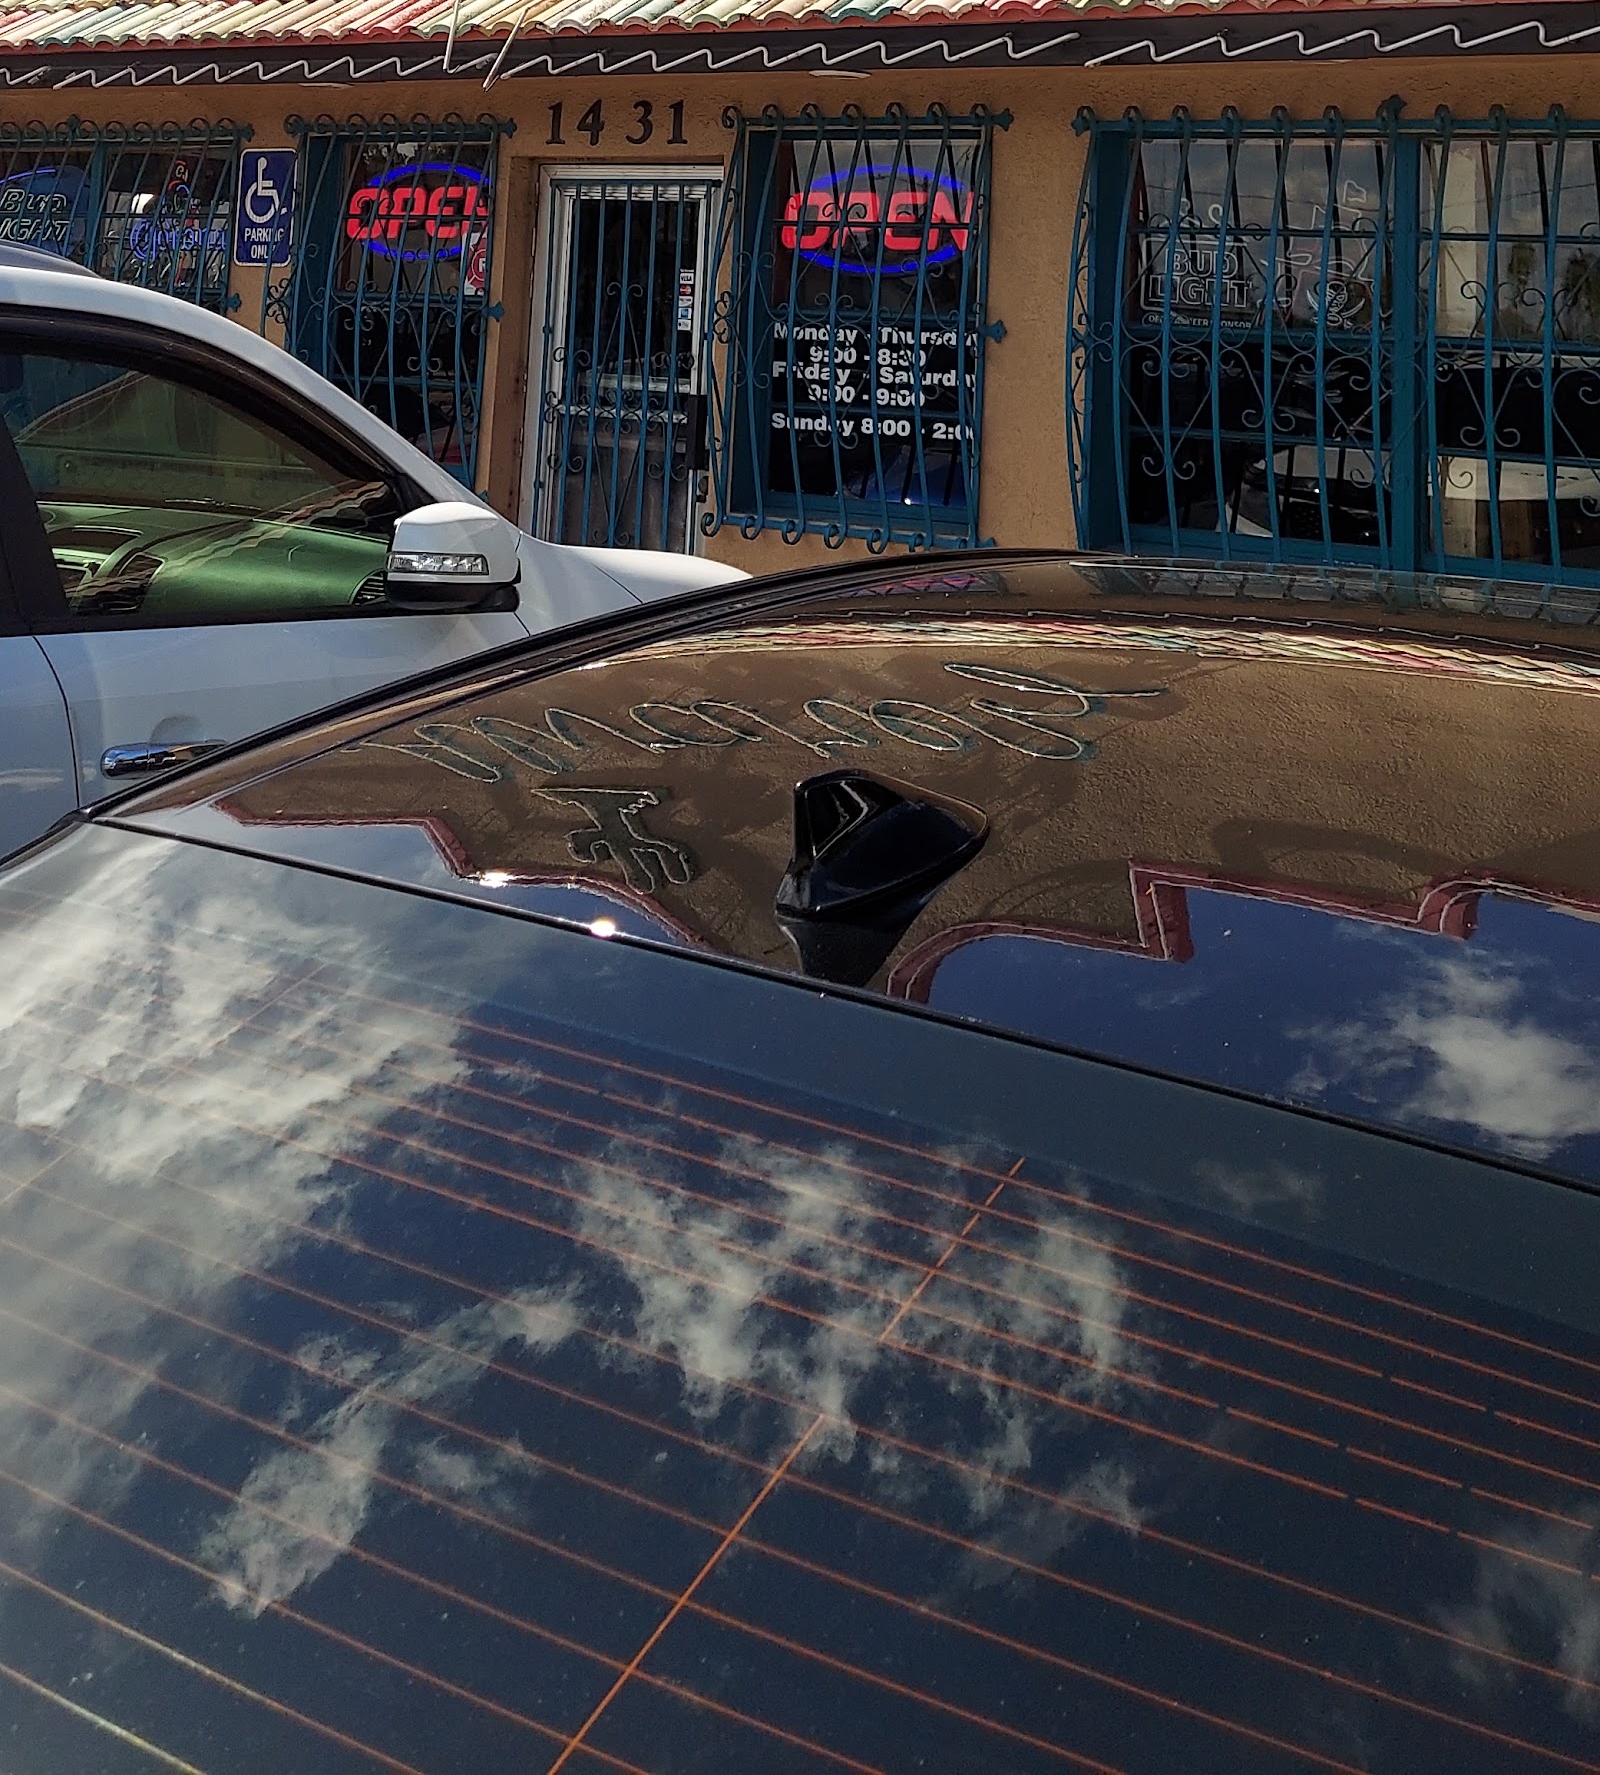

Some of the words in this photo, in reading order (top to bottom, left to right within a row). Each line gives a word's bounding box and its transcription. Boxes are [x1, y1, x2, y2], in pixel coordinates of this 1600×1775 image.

[545, 99, 688, 146] 1431
[345, 185, 489, 240] OPEN
[781, 191, 975, 251] OPEN
[0, 218, 73, 241] IGHT
[1165, 248, 1239, 279] BUD
[1148, 274, 1248, 308] LIGHT
[774, 323, 858, 345] Monday
[809, 346, 857, 364] 9:00
[877, 348, 926, 367] 8:30
[772, 361, 851, 386] Friday
[808, 384, 856, 403] 9:00
[876, 388, 925, 407] 9:00
[861, 418, 911, 436] 8:00
